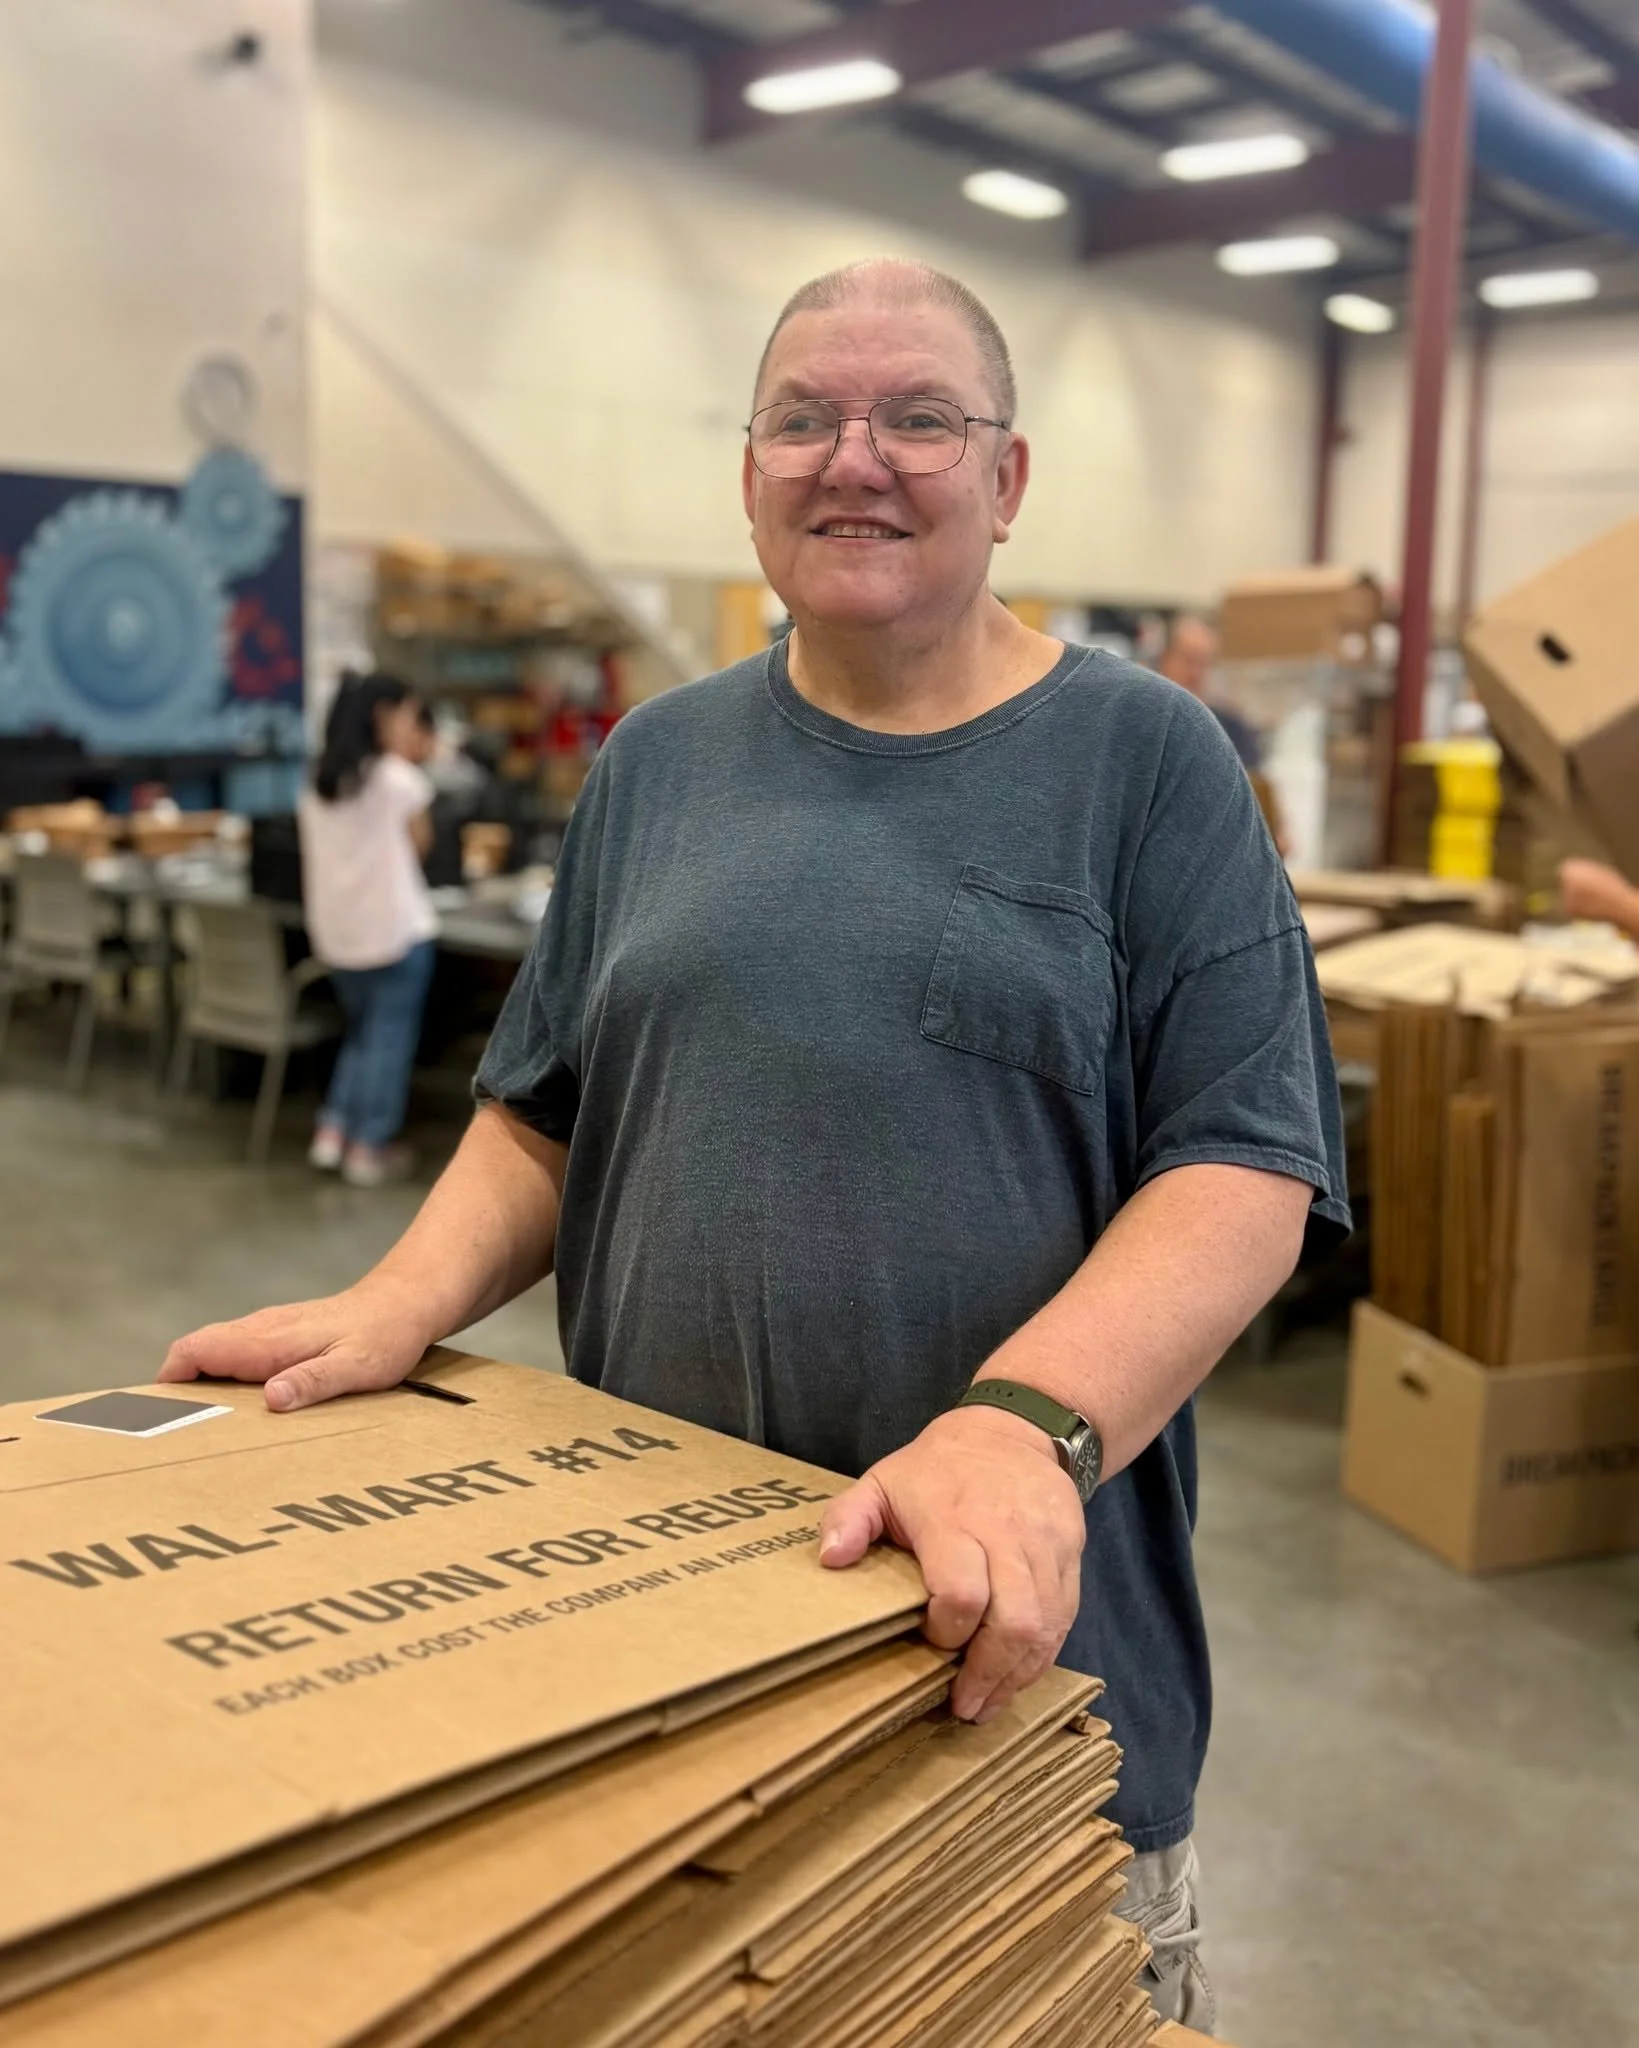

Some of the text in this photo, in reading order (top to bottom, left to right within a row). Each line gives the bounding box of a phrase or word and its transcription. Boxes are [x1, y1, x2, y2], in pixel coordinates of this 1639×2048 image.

[8, 1427, 683, 1589] WAL-MART #14
[163, 1478, 833, 1669] RETURN FOR REUSE
[212, 1675, 326, 1716] EACH
[318, 1652, 403, 1684] BOX
[397, 1626, 488, 1660] COST
[479, 1607, 553, 1634] THE
[544, 1567, 683, 1615] COMPANY
[677, 1556, 725, 1576] AN
